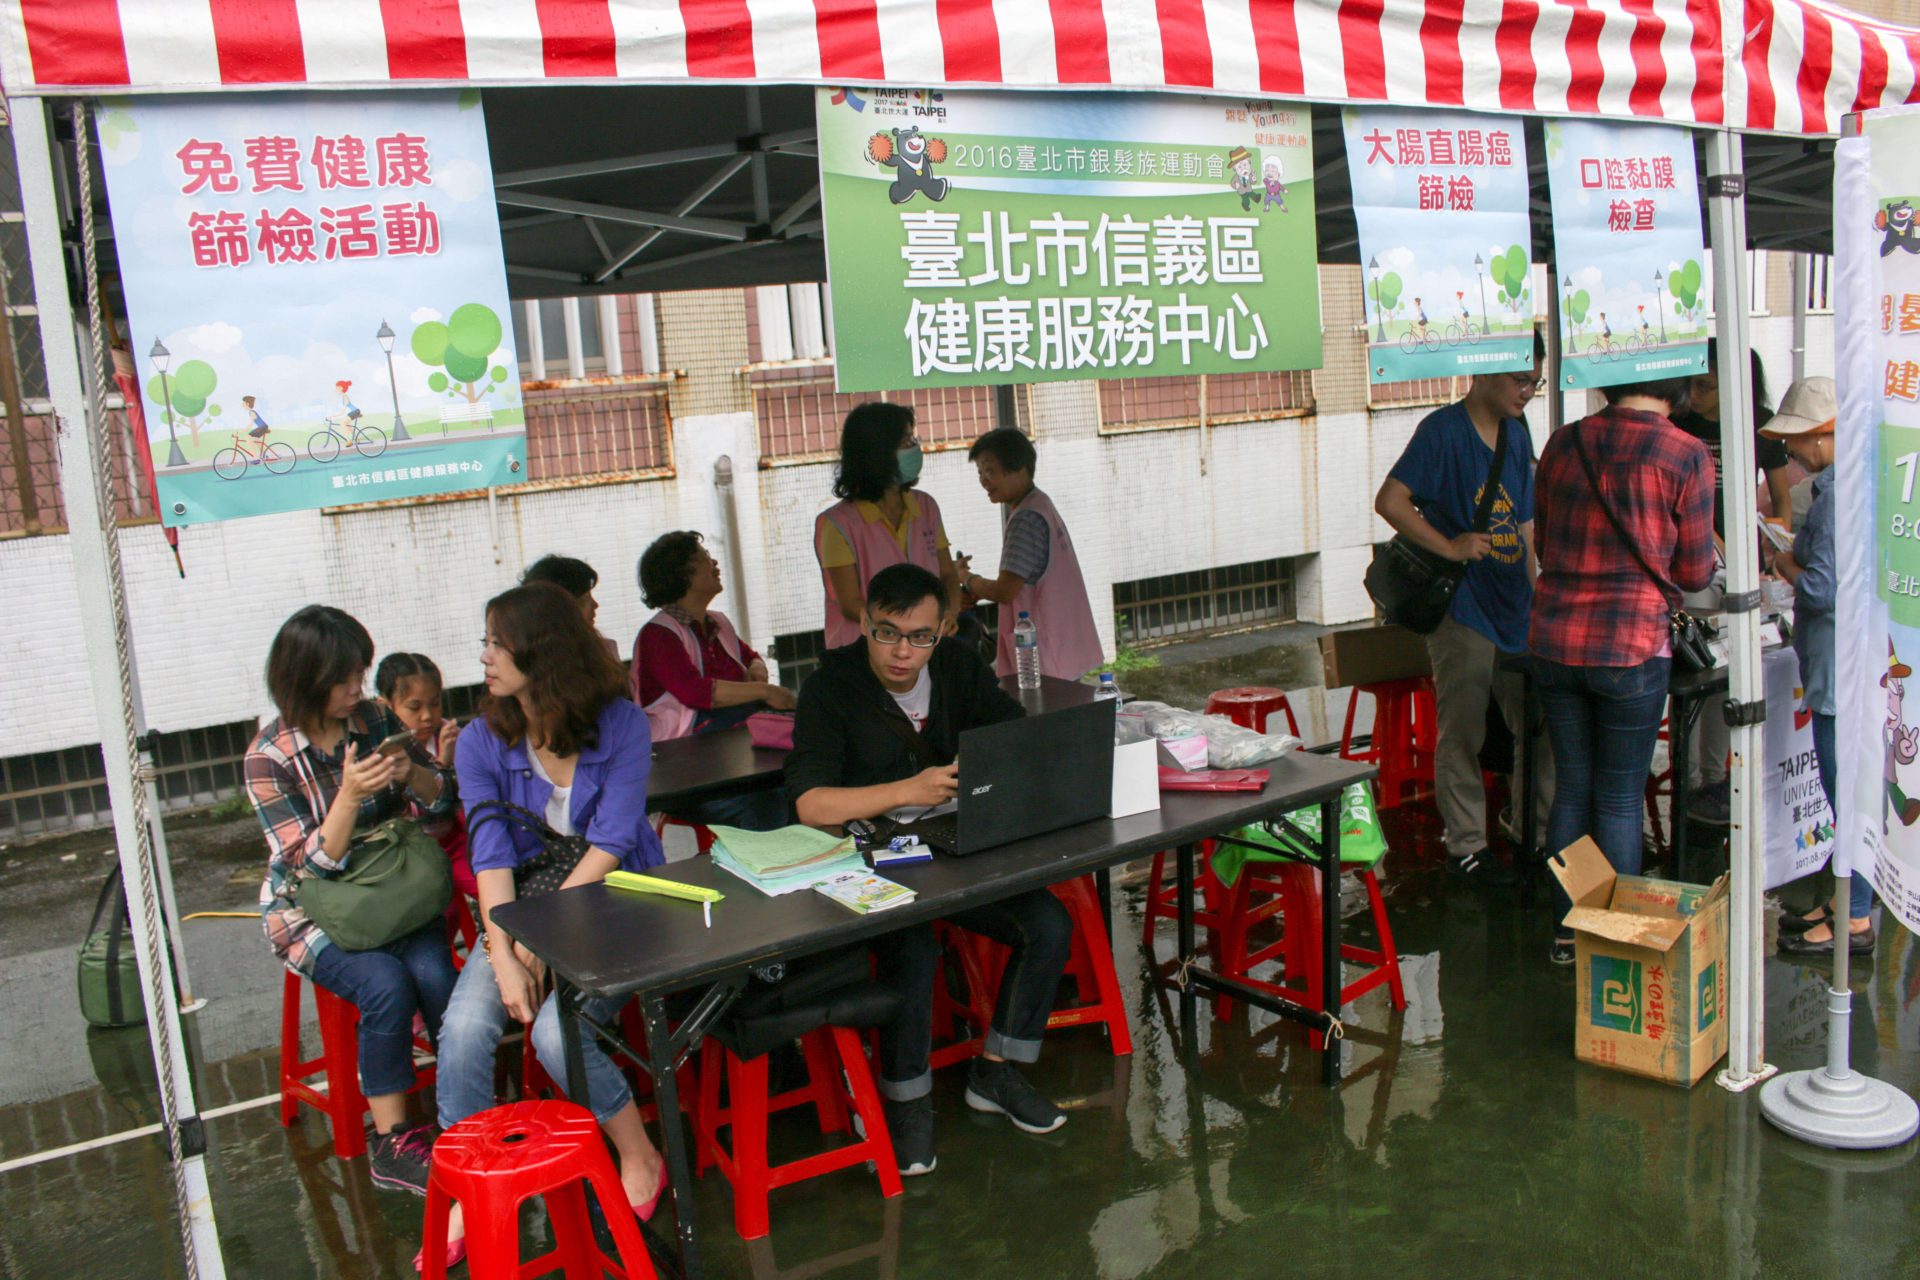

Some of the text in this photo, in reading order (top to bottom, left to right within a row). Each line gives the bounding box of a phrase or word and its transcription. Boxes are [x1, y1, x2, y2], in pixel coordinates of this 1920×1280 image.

[912, 106, 947, 118] TAIPEI
[175, 132, 433, 195] 免費健康
[954, 144, 1225, 180] 2016臺北市銀髮族運動會
[1362, 128, 1513, 168] 大腸直腸癌
[1580, 156, 1677, 191] 口腔黏膜
[1417, 174, 1475, 212] 篩檢
[188, 200, 442, 267] 篩檢活動
[1607, 198, 1656, 233] 檢查
[900, 210, 1264, 288] 臺北市信義區
[904, 292, 1269, 377] 健康服務中心
[972, 784, 993, 796] acer
